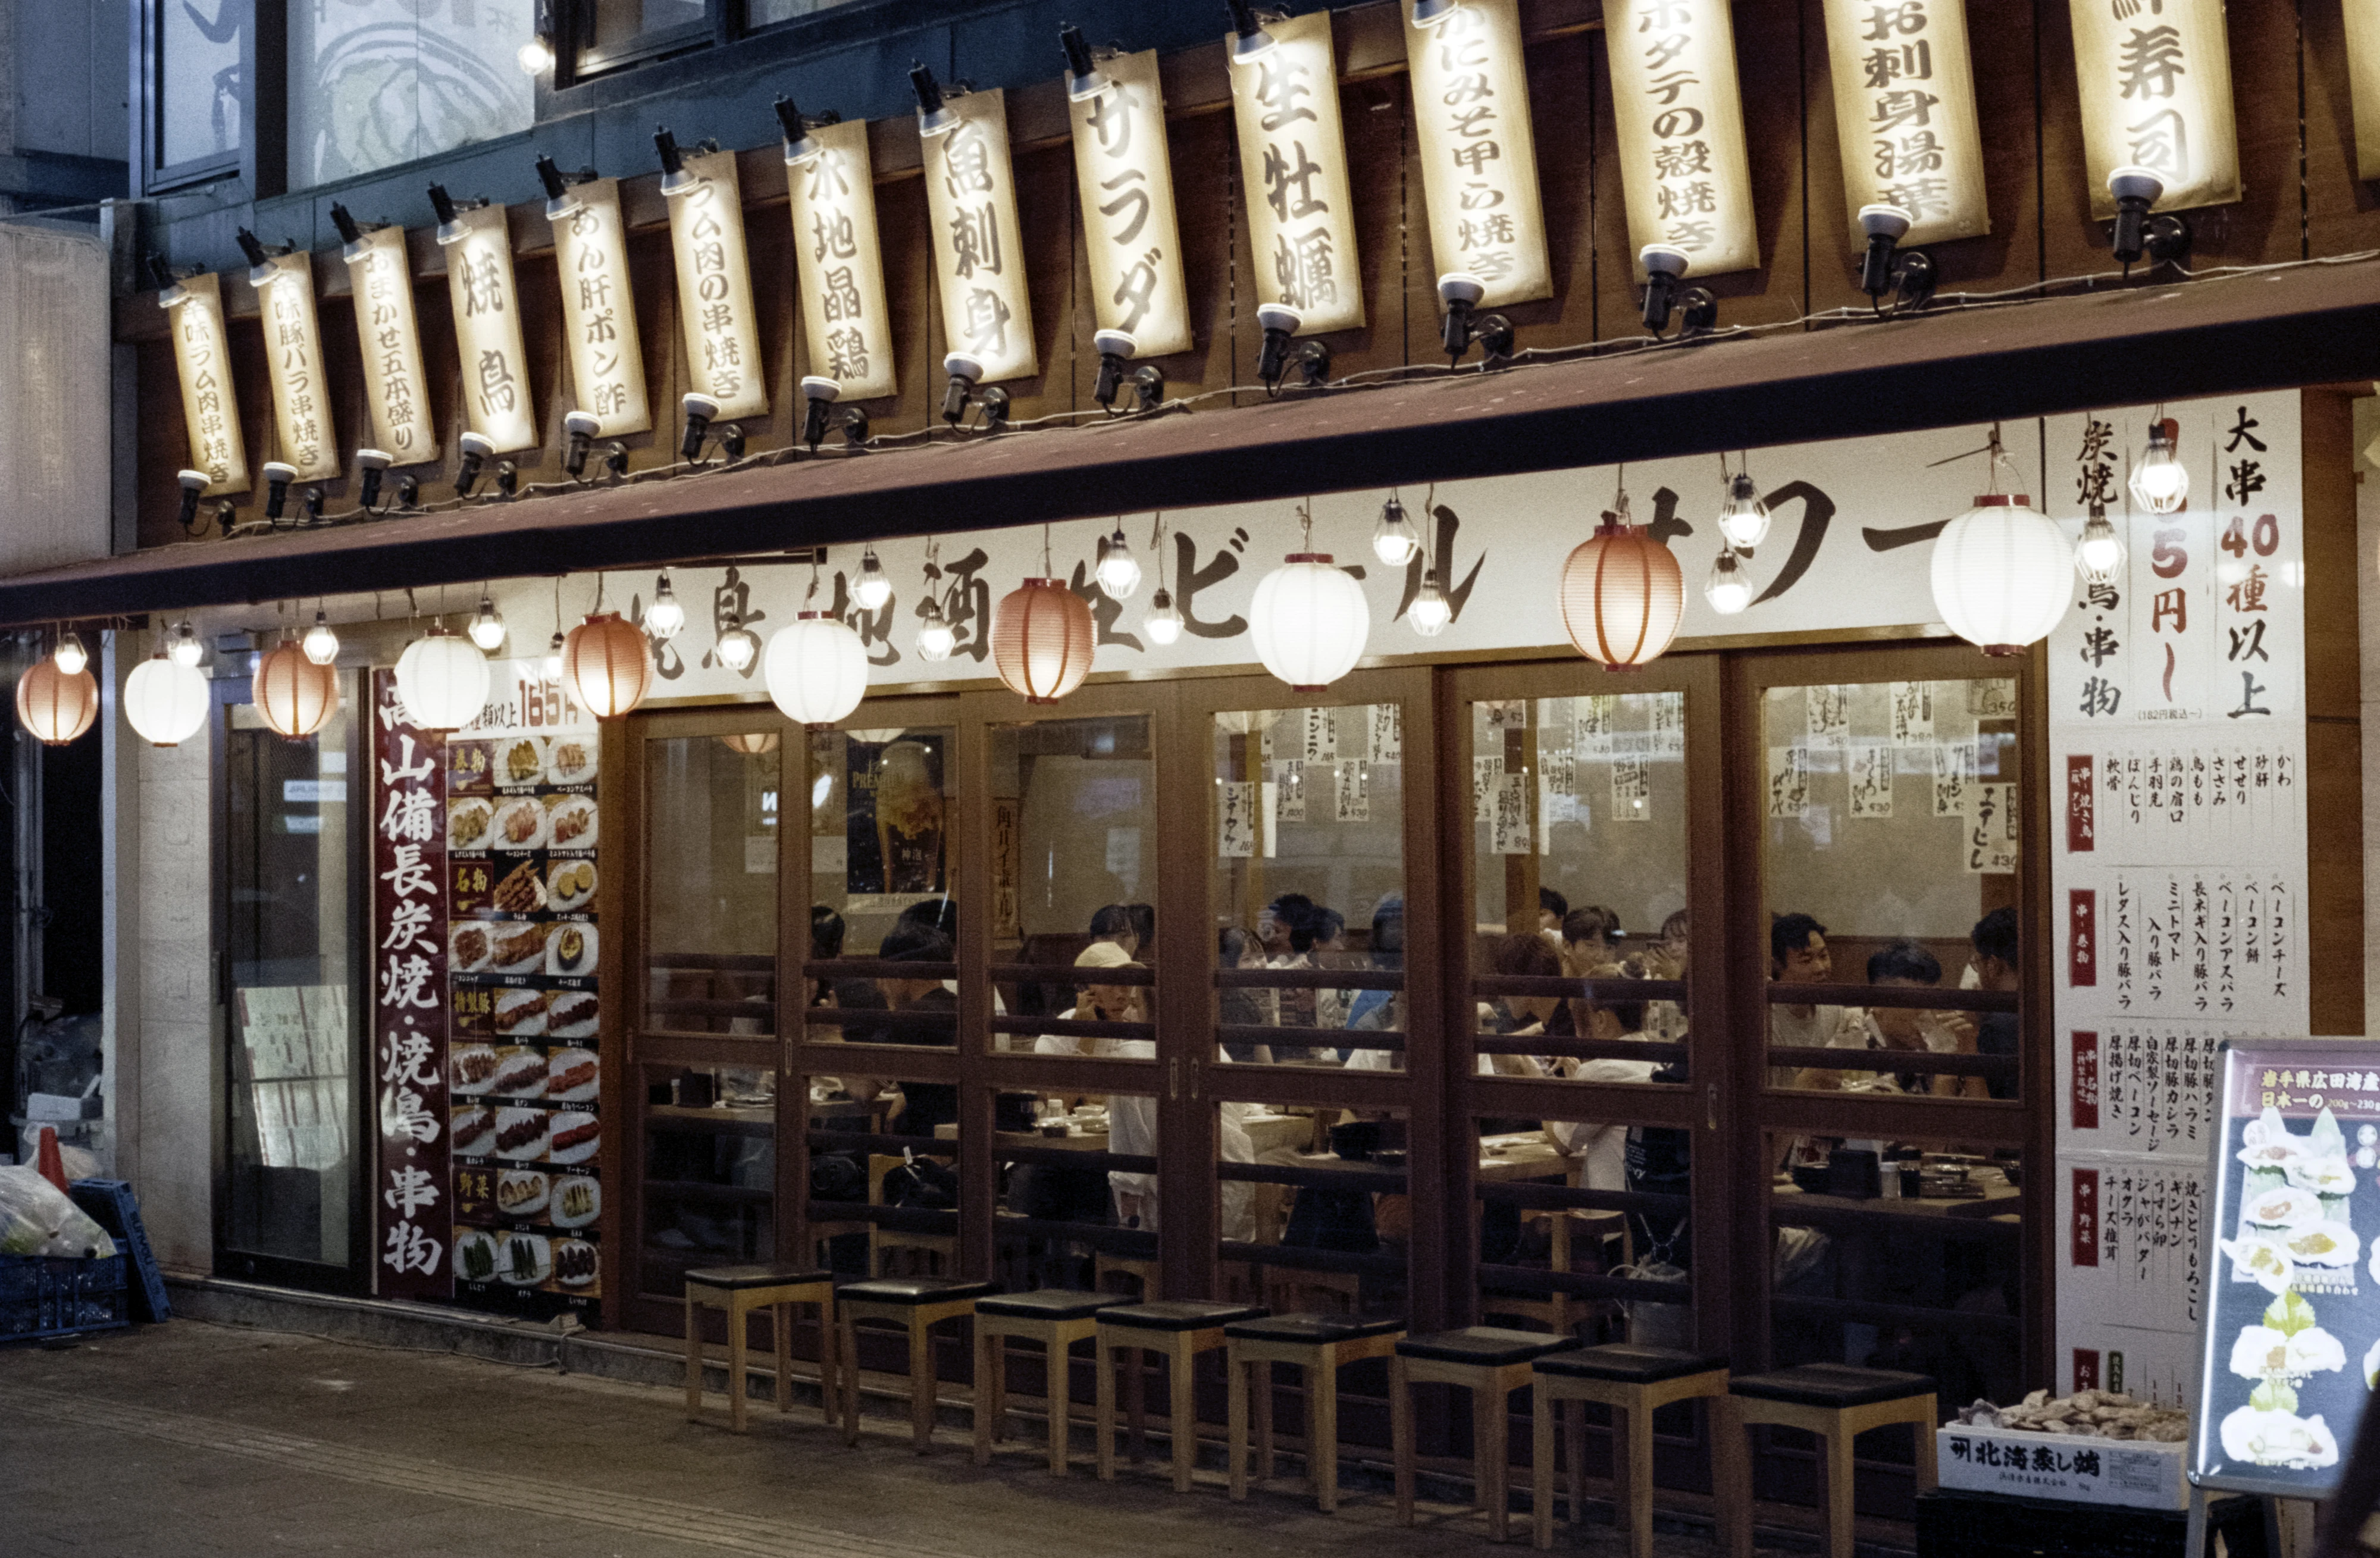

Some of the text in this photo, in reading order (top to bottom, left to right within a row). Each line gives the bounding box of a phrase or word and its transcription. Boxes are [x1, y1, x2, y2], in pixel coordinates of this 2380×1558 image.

[2111, 0, 2189, 179] 寿司
[1086, 81, 1162, 335] サラダ
[1255, 48, 1338, 311] 生牡蠣
[364, 248, 414, 451] おまかせ五本盛り
[461, 251, 516, 416] 焼鳥
[571, 206, 625, 416] あん肝ポン酢
[274, 275, 321, 468] 辛味豚バラ串焼き
[2106, 758, 2121, 791] 軟骨
[2128, 757, 2141, 825] ぼんじり
[2148, 757, 2163, 808] 手羽先
[2190, 756, 2204, 806] 鳥もも
[2213, 756, 2226, 805] ささみ
[2234, 755, 2247, 805] せせり
[2277, 754, 2291, 786] かわ
[2116, 882, 2131, 1010] レタス入り豚バラ
[2167, 882, 2181, 962] ミニトマト
[2218, 881, 2234, 1012] ベーコンアスパラ
[2271, 881, 2287, 998] ベーコンチーズ
[2109, 1035, 2124, 1119] 厚揚げ焼き
[2146, 1036, 2160, 1152] 自家製ソーセージ
[2262, 1090, 2323, 1109] 日本一の
[2122, 1177, 2133, 1226] オクラ
[2152, 1179, 2167, 1247] うずら卵
[2170, 1180, 2183, 1247] ギンナン
[2185, 1180, 2200, 1321] 焼きとうもろこし
